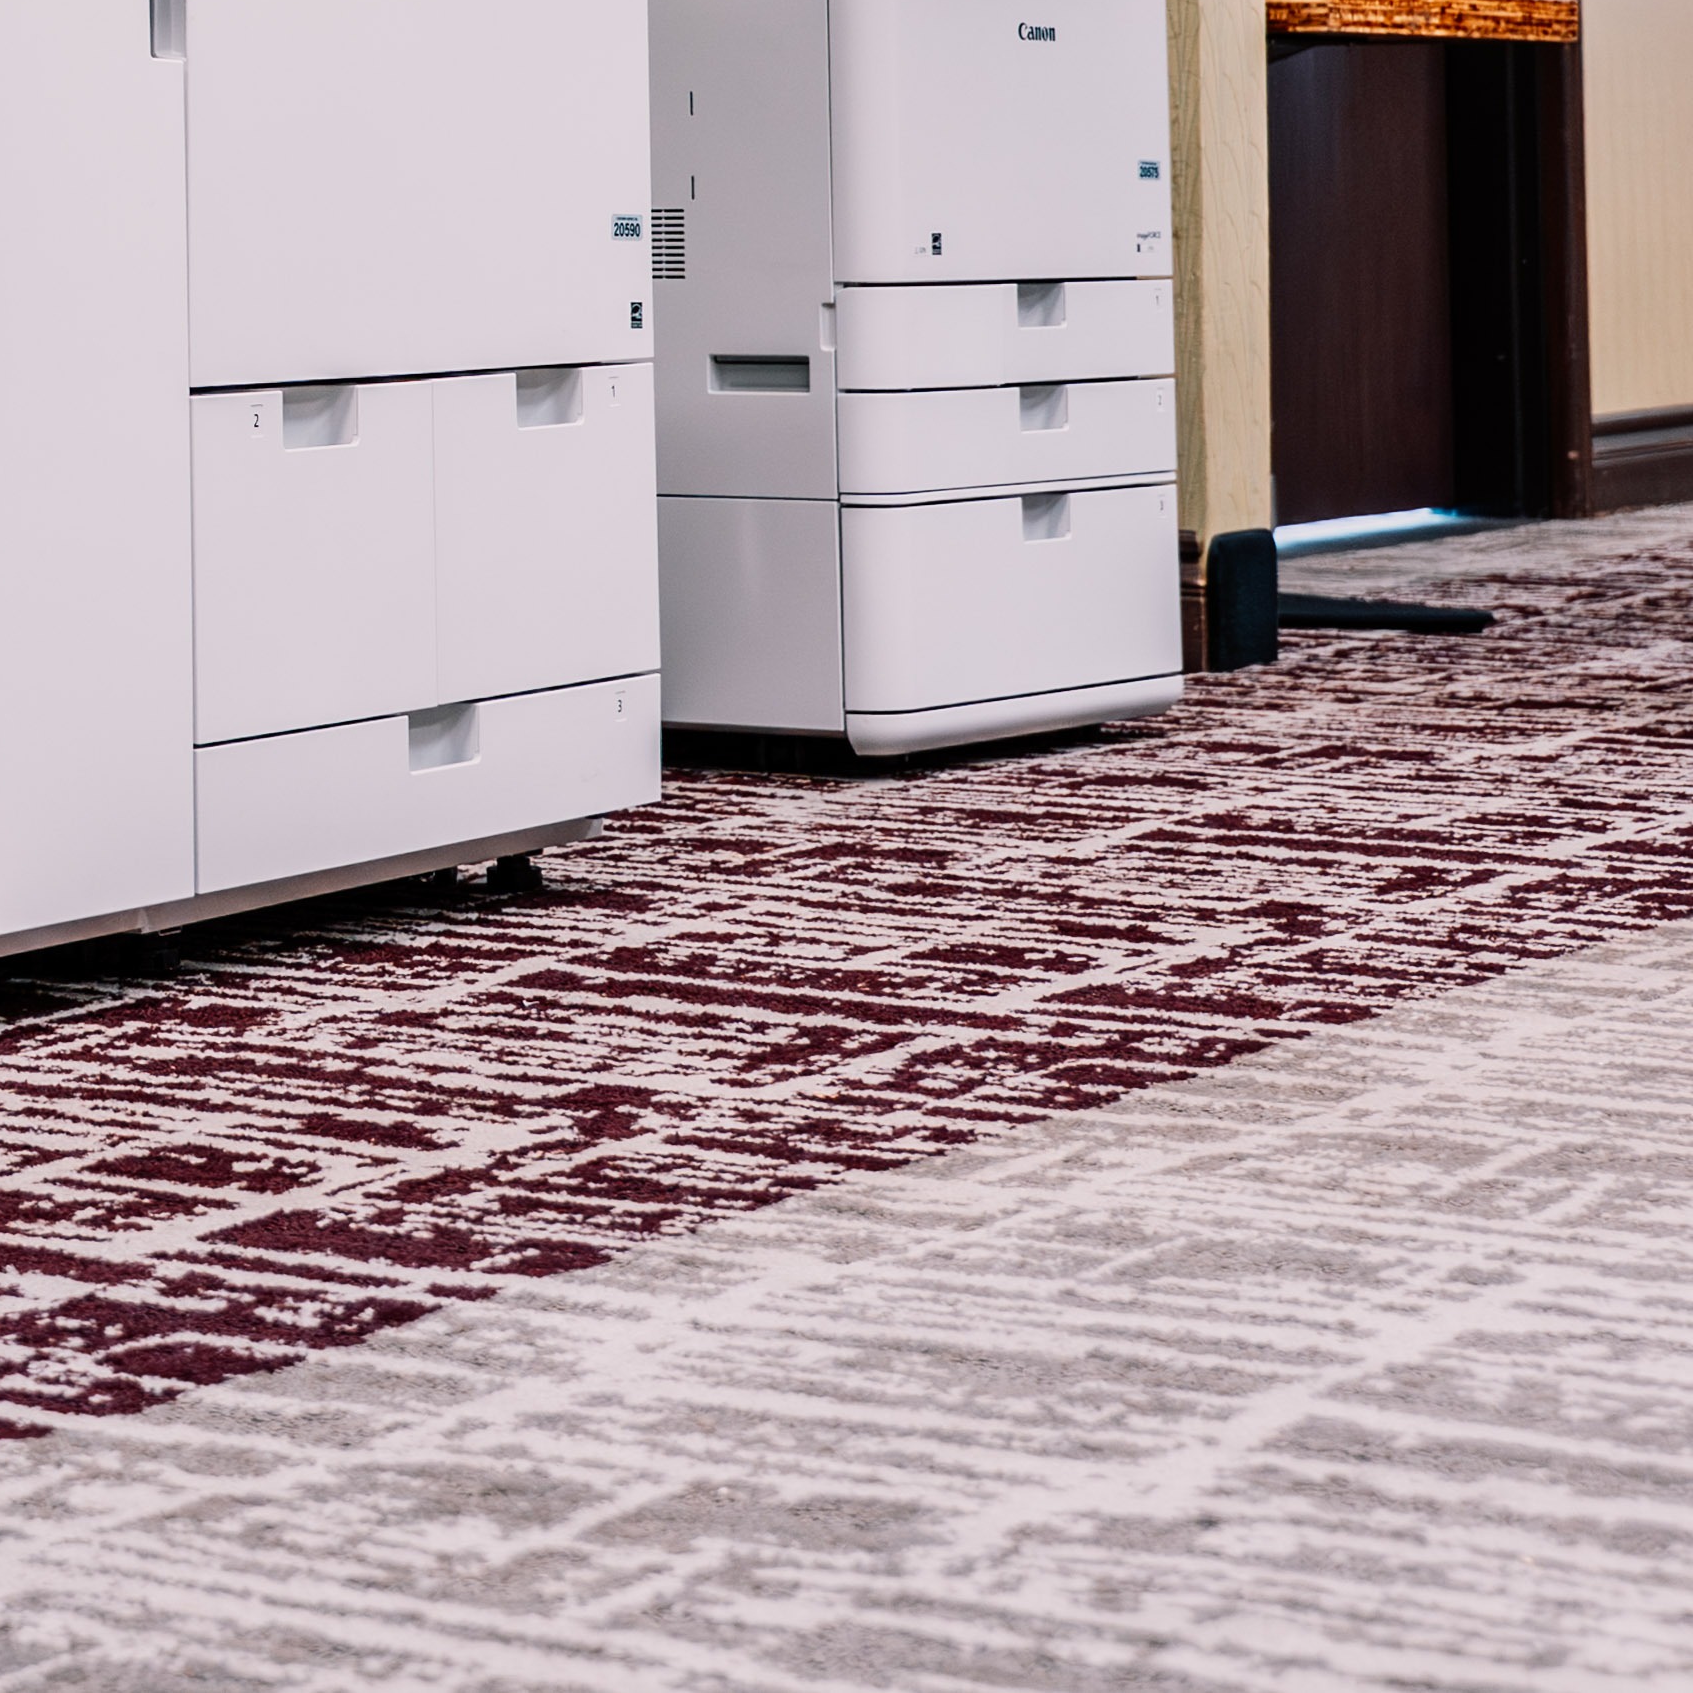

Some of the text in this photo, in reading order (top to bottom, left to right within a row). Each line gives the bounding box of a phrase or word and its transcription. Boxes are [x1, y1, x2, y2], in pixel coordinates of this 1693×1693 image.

[1018, 22, 1056, 42] Canon
[614, 222, 641, 237] 20590
[253, 413, 260, 428] 2
